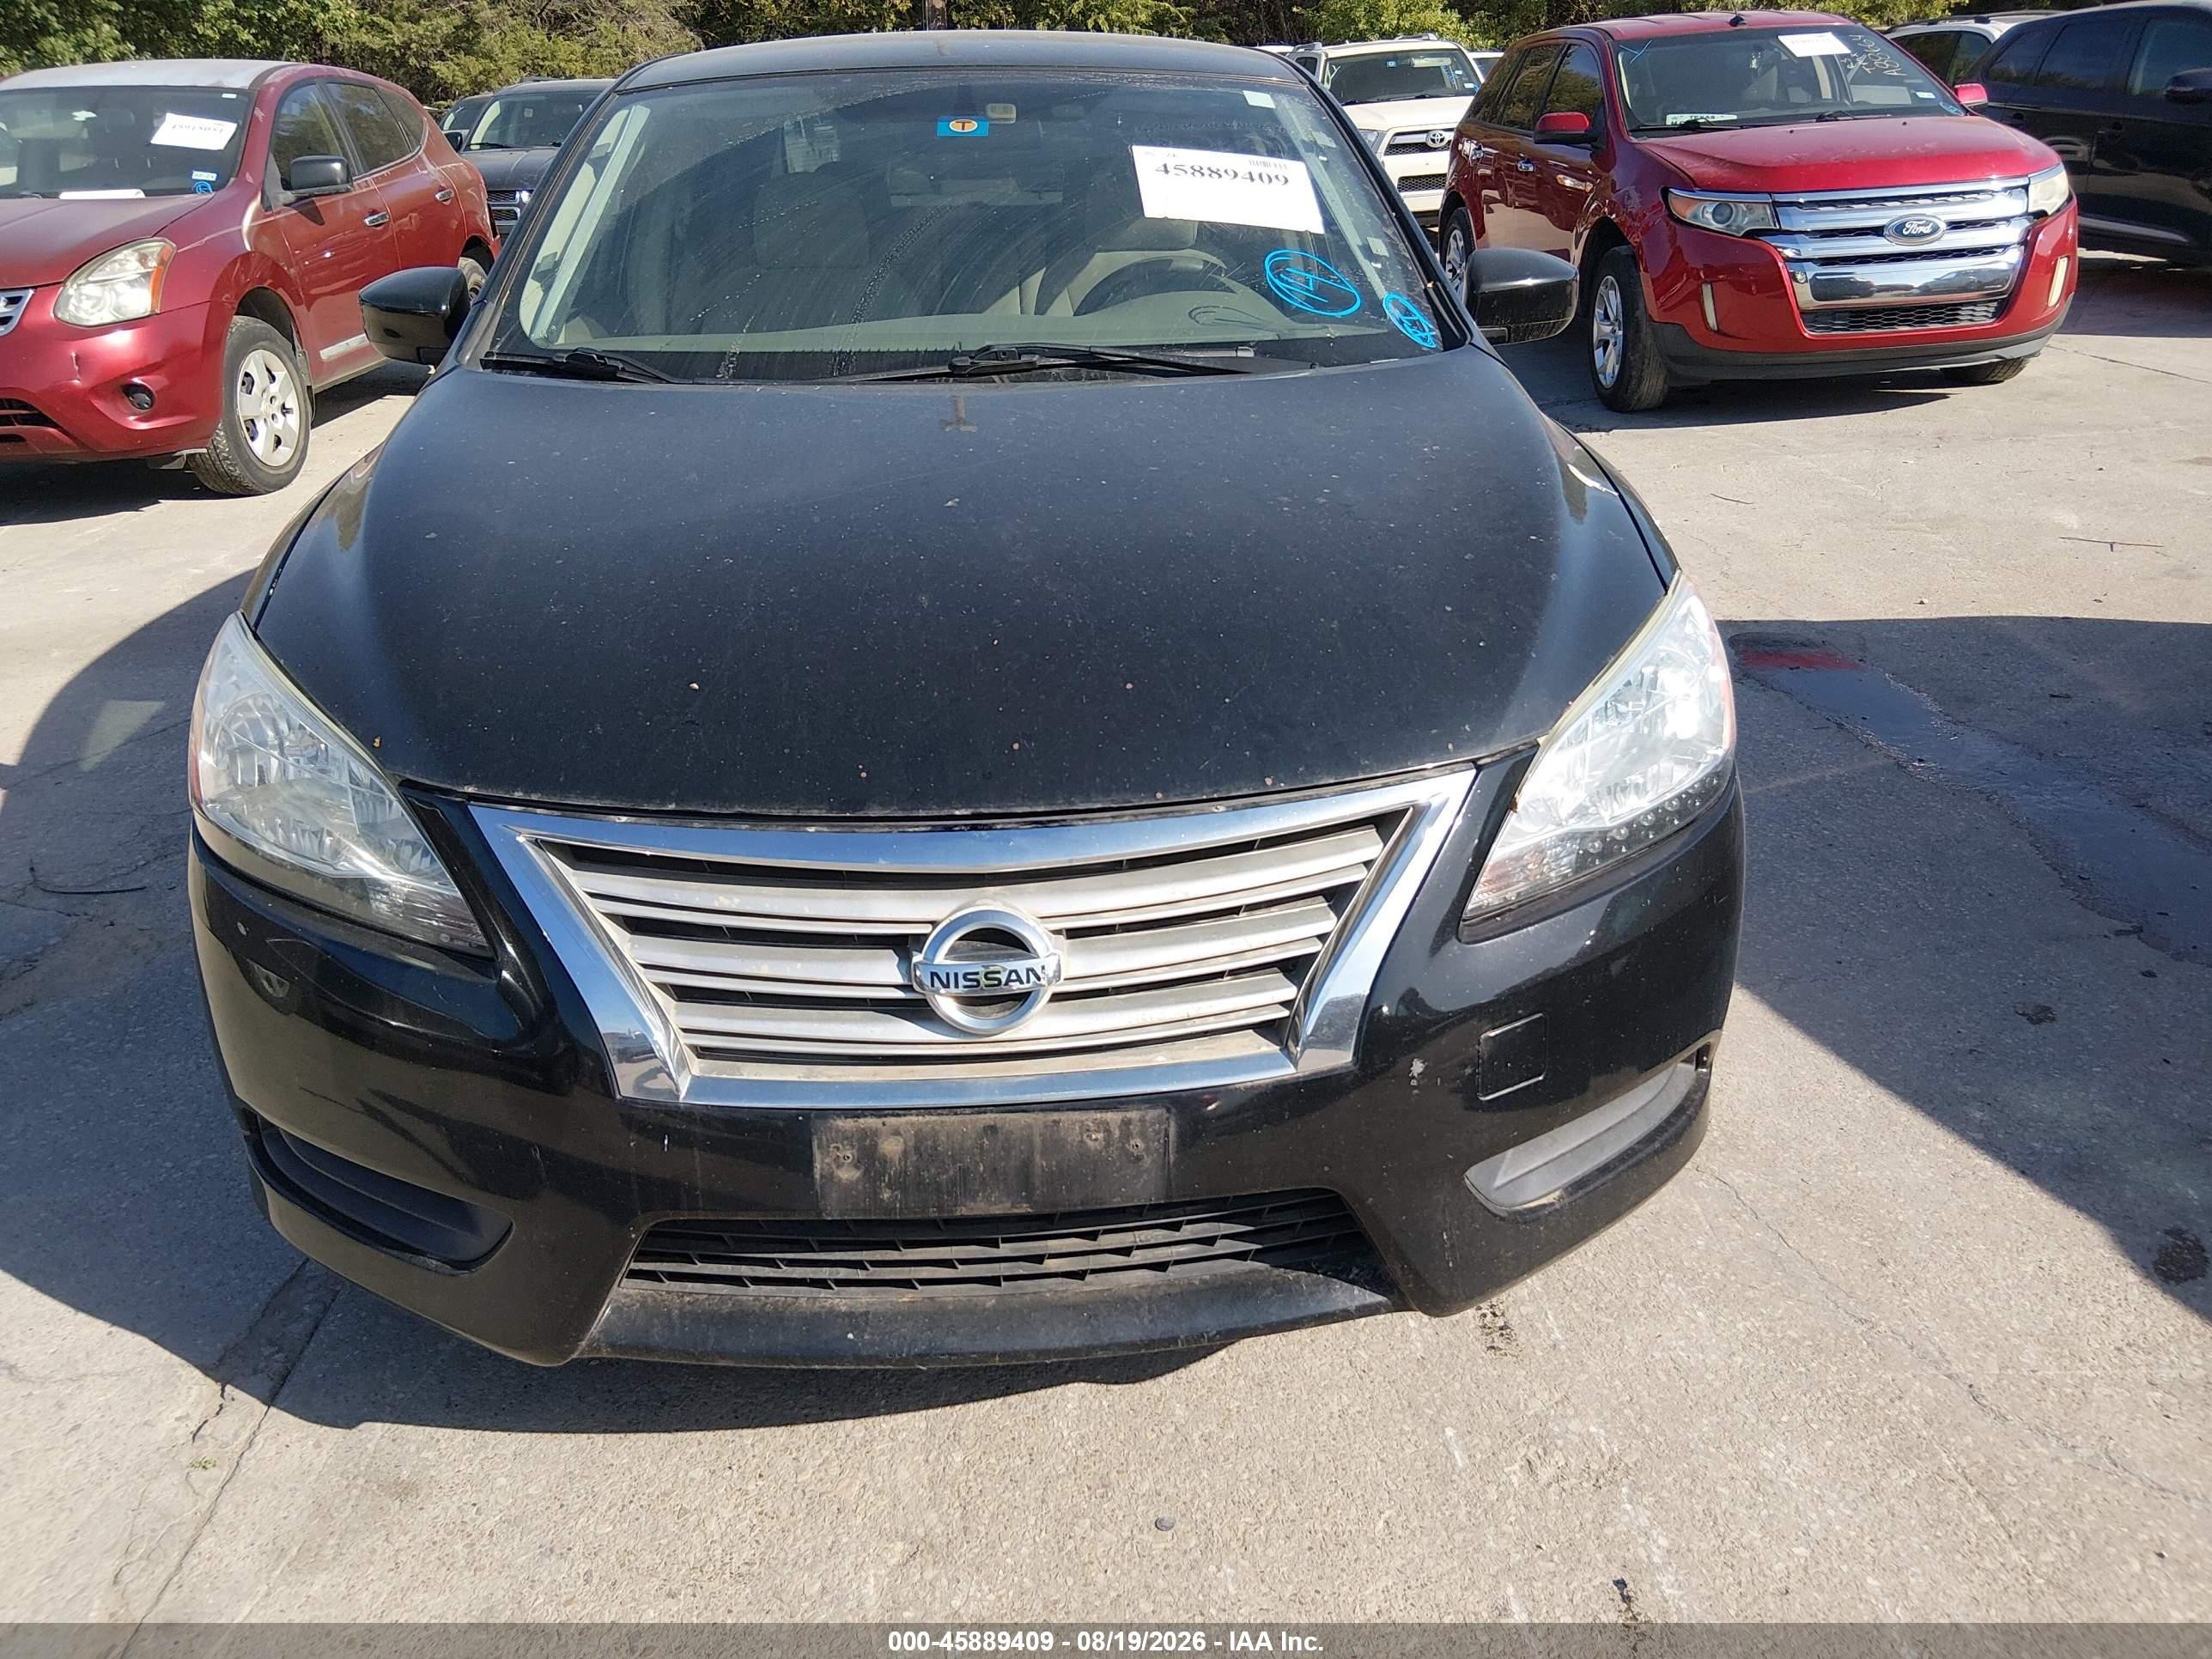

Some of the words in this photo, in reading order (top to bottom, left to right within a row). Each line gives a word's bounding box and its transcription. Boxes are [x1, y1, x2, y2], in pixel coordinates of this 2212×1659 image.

[1155, 162, 1289, 186] 45889409
[1903, 220, 1934, 235] Ford
[929, 964, 1046, 990] NISSAN
